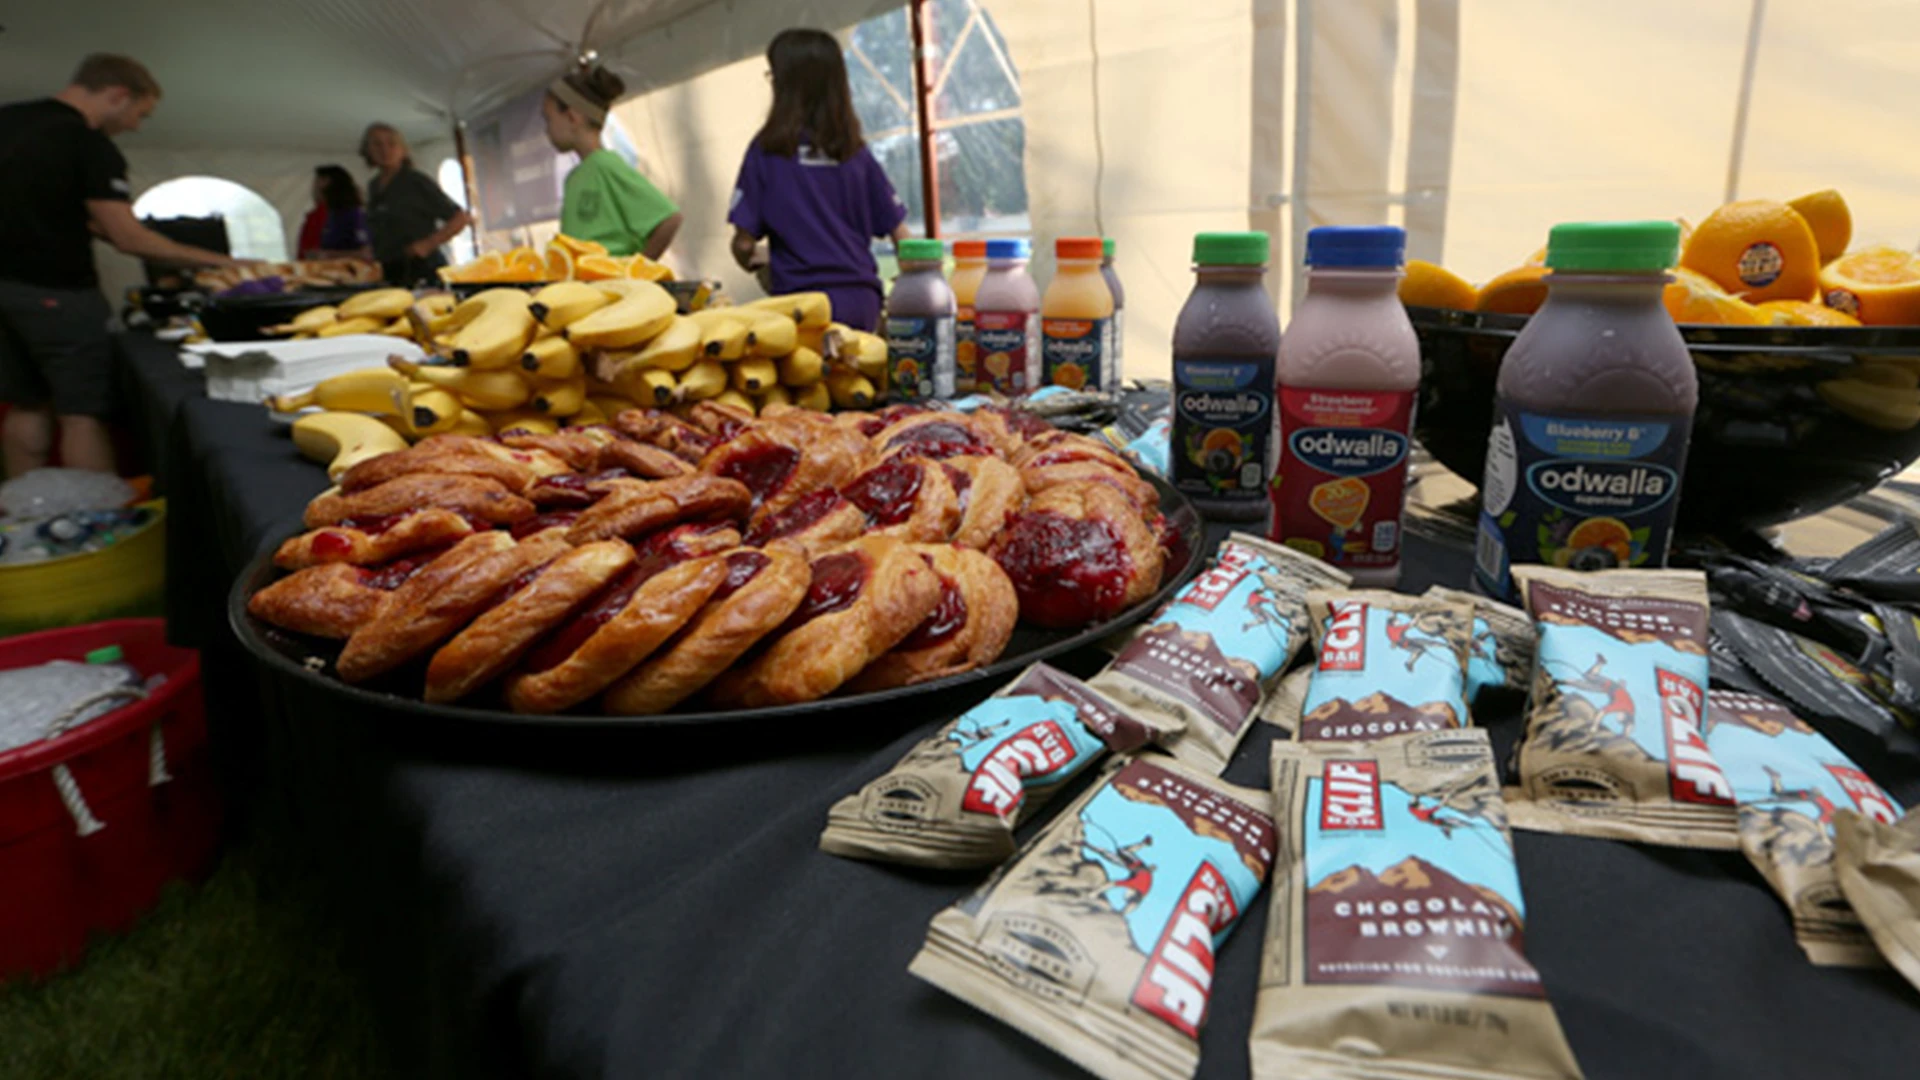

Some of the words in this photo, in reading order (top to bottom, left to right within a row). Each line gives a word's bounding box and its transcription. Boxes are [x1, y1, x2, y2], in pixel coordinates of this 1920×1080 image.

[1183, 393, 1260, 414] odwalla
[1298, 432, 1399, 458] odwalla
[1546, 423, 1624, 442] Blueberry
[1539, 465, 1664, 495] odwalla
[1145, 636, 1246, 692] CHOCOLATE
[1148, 648, 1222, 693] BROWNIE
[1322, 651, 1361, 663] BAR
[1031, 723, 1068, 764] BAR
[1320, 721, 1441, 739] CHOCOLA
[1667, 695, 1734, 798] CLIF
[971, 737, 1050, 810] CLIF
[1327, 763, 1376, 818] CLIF
[1333, 897, 1508, 918] CHOCOLA
[1150, 888, 1218, 1027] CLIF
